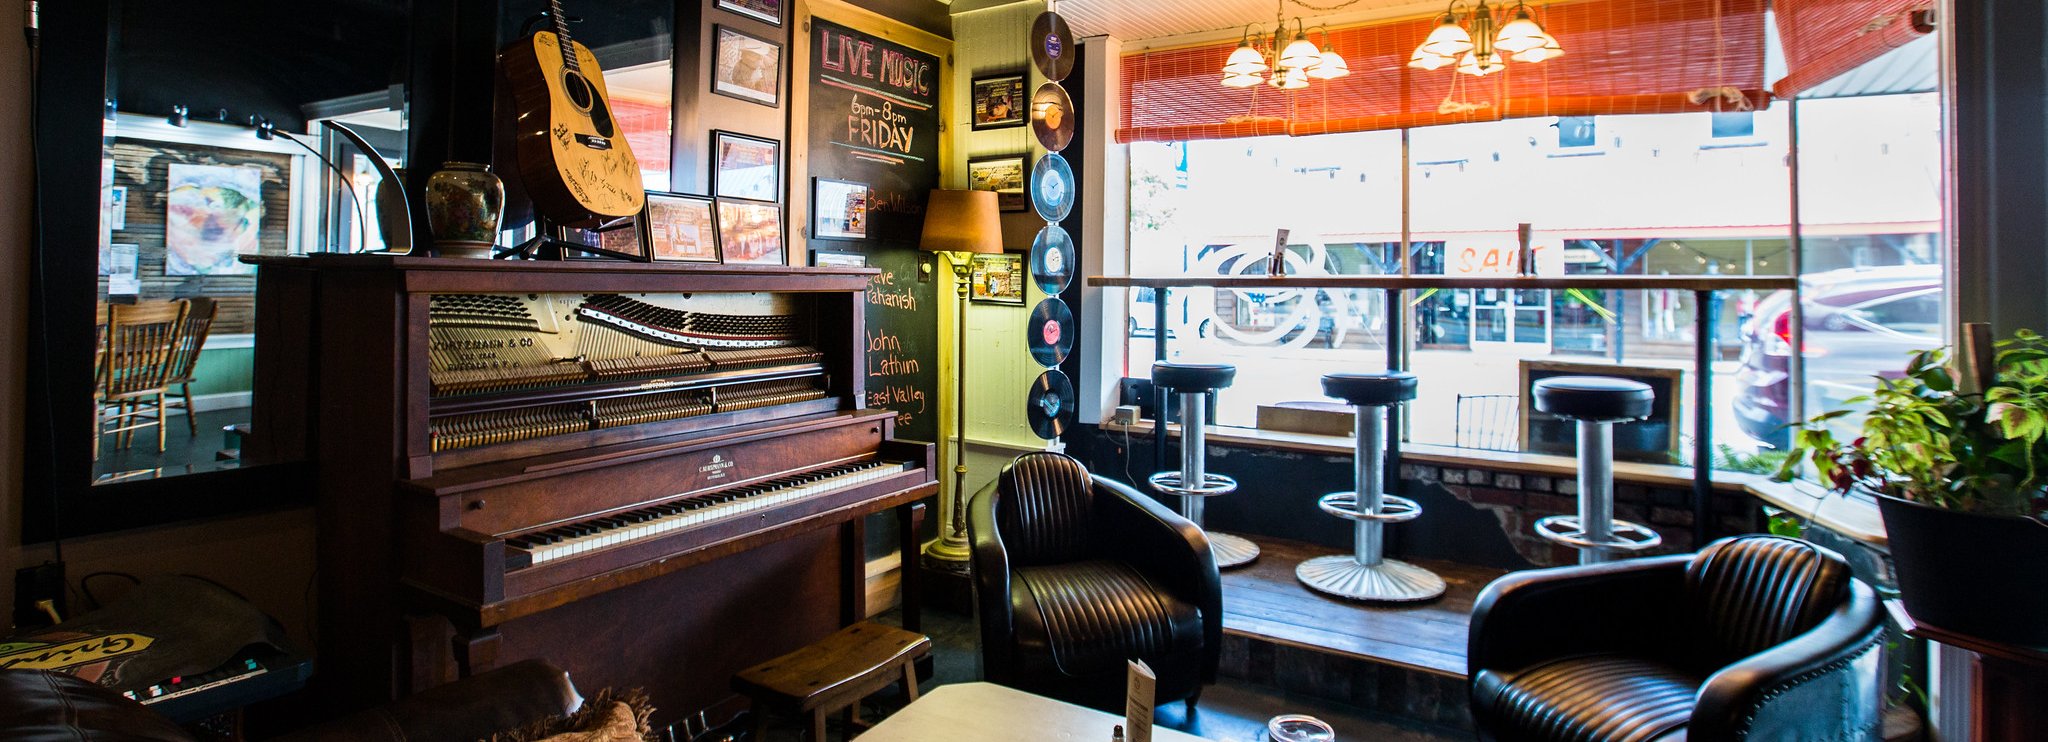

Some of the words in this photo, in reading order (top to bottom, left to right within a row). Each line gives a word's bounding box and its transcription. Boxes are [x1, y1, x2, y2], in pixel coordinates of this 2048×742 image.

[822, 29, 874, 79] LIVE
[880, 48, 930, 97] MUSIC
[848, 114, 914, 153] FRIDAY
[1458, 246, 1546, 273] SAL
[867, 328, 901, 353] John
[891, 385, 925, 414] Valley
